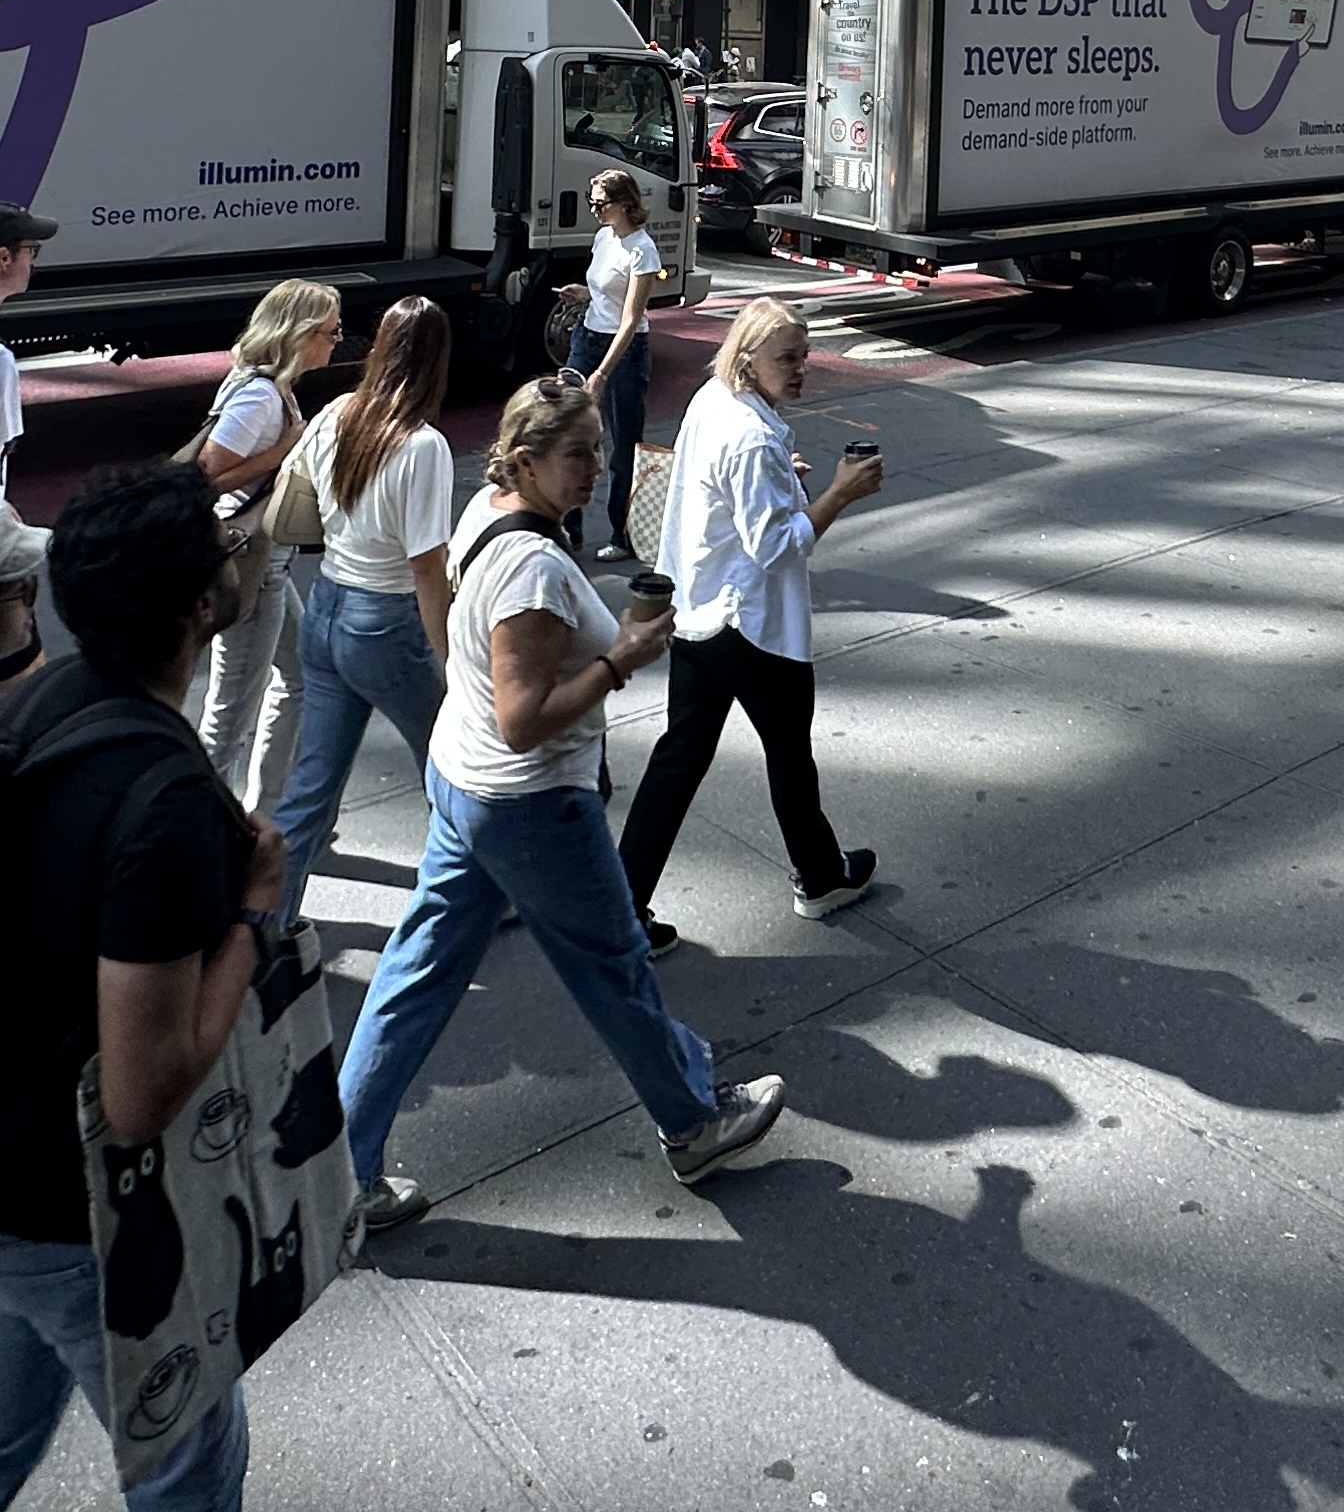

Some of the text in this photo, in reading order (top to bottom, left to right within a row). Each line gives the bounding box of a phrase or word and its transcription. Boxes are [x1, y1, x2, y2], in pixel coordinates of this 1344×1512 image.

[837, 17, 871, 30] country
[963, 35, 1159, 81] never sleeps.
[963, 95, 1148, 119] Demand more from your
[962, 124, 1136, 151] demand-side platform.
[1264, 147, 1279, 159] See
[1304, 144, 1334, 156] Achieve
[199, 158, 360, 186] illumin.com
[91, 195, 360, 226] See more. Achieve more.
